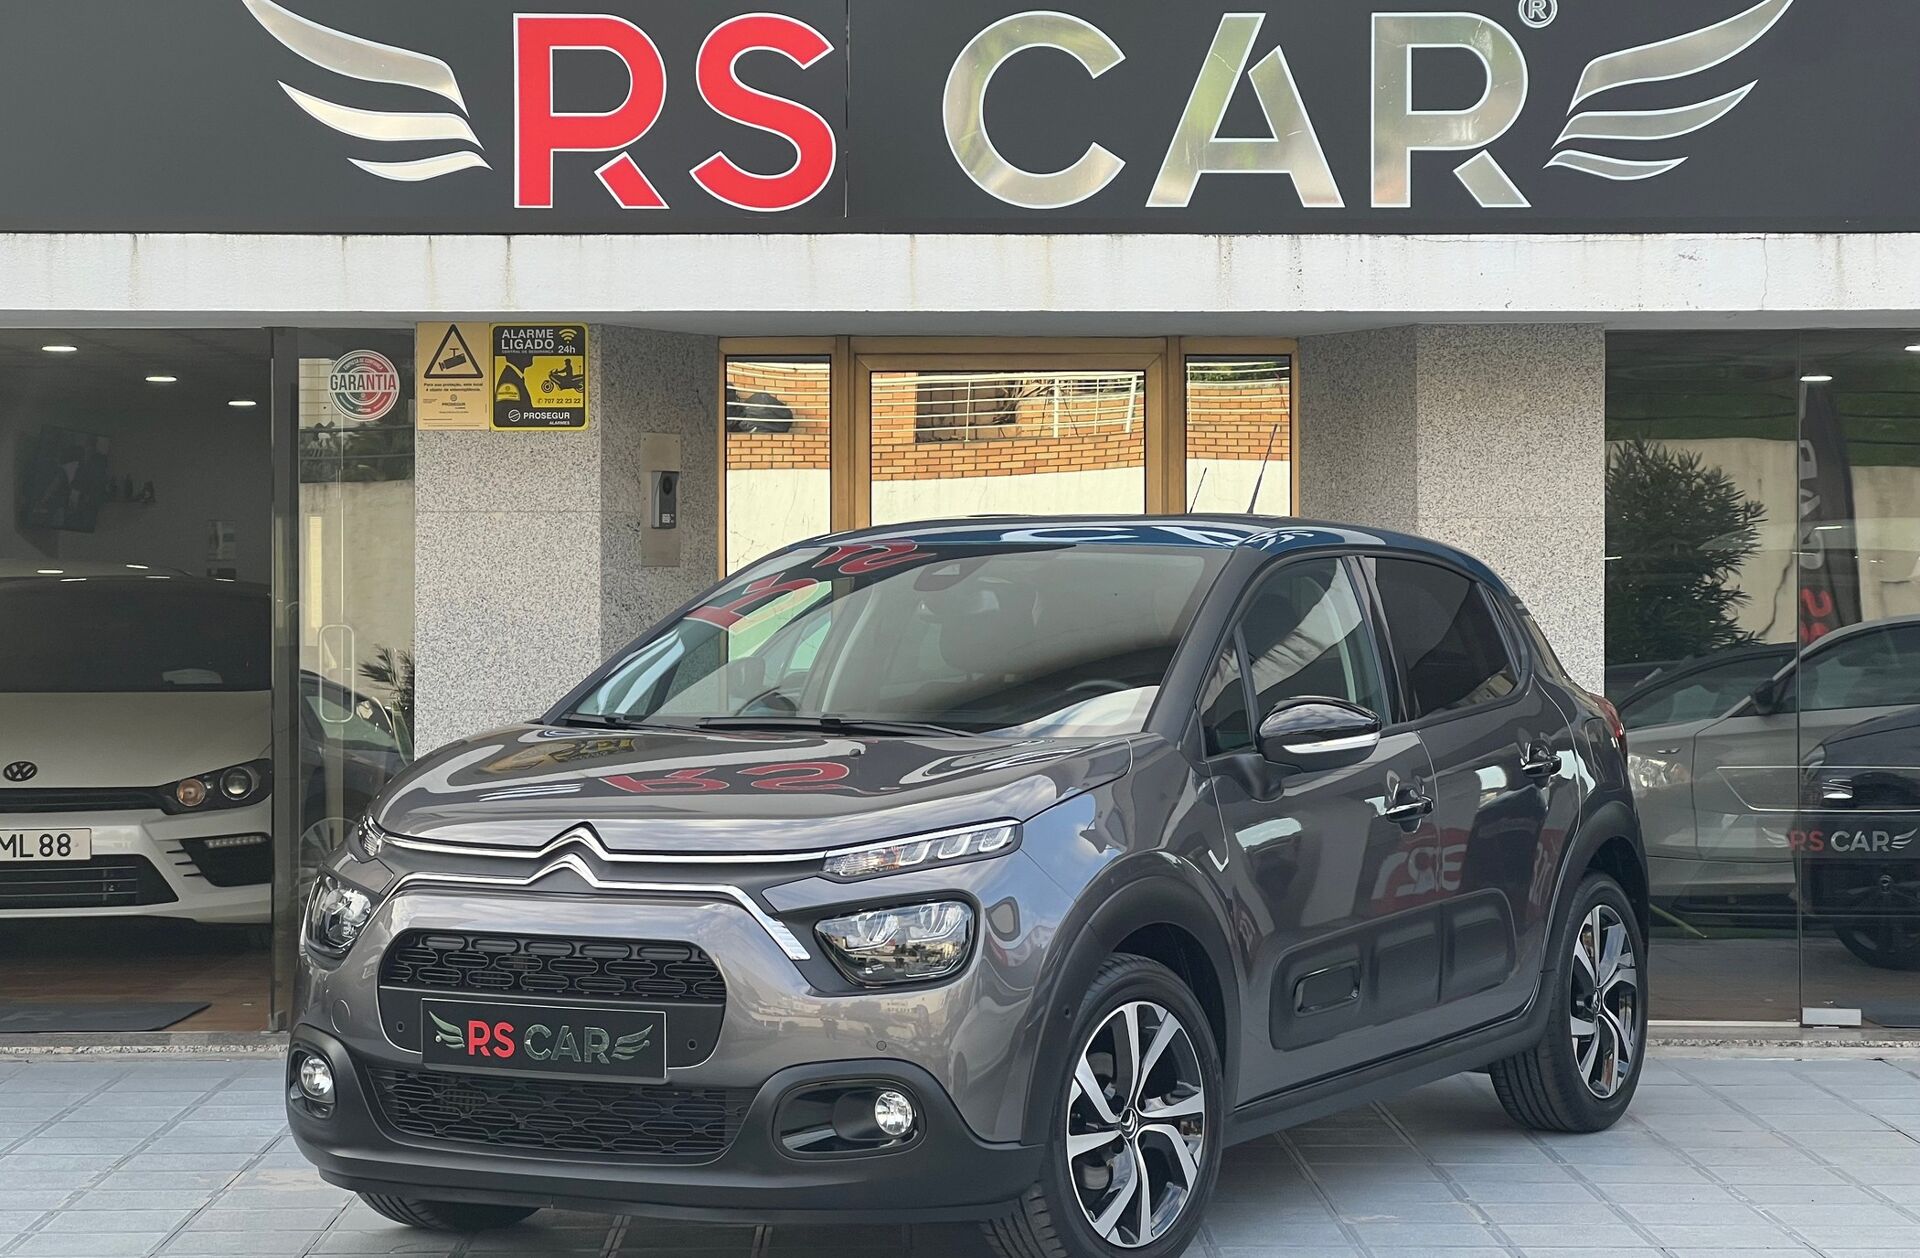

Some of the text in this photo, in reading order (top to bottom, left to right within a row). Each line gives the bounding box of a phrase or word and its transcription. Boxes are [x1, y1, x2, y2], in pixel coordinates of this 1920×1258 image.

[513, 12, 837, 213] RS
[943, 10, 1531, 209] CAR
[502, 329, 554, 339] ALARME
[501, 339, 576, 354] LIGADO 24h
[330, 374, 397, 391] GARANTIA
[523, 412, 571, 420] PROSEGUR
[39, 833, 71, 857] 88
[1789, 829, 1890, 852] RS CAR
[468, 1020, 611, 1065] RS CAR
